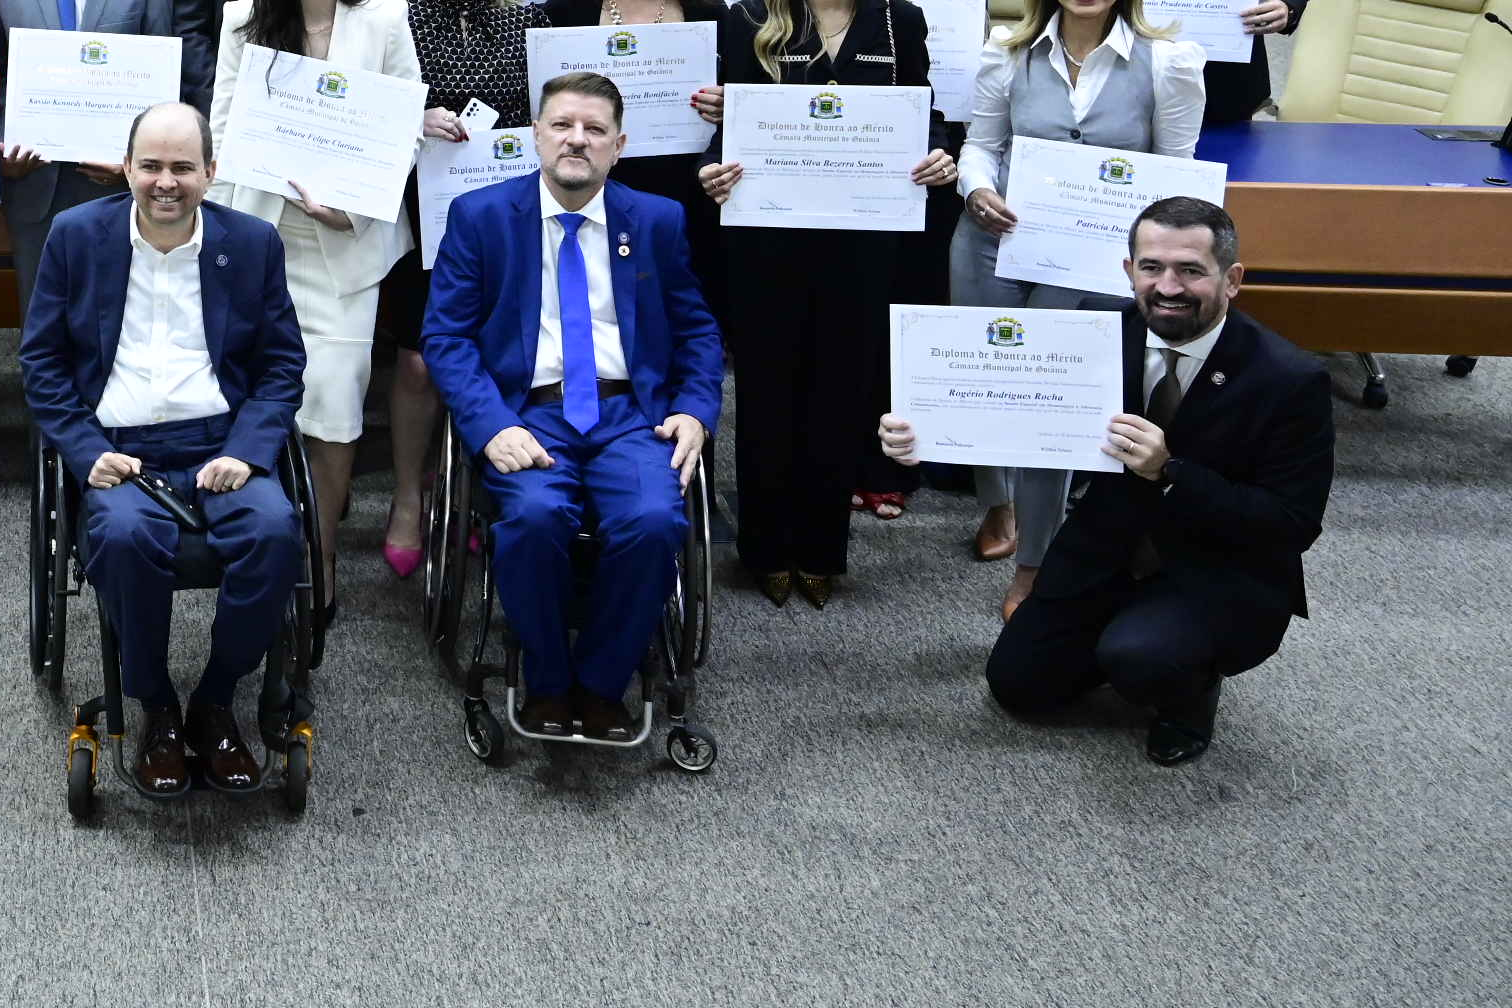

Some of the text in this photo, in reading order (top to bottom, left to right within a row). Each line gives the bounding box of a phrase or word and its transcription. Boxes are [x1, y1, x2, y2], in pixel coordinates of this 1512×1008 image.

[758, 121, 798, 132] Diploma
[764, 158, 884, 169] Mariana Silva Bezerra Santos
[1075, 218, 1110, 231] Patrícia
[930, 347, 1083, 364] Diploma de Honra ao Mérito
[949, 388, 1063, 401] Rogério Rodrigues Rocha
